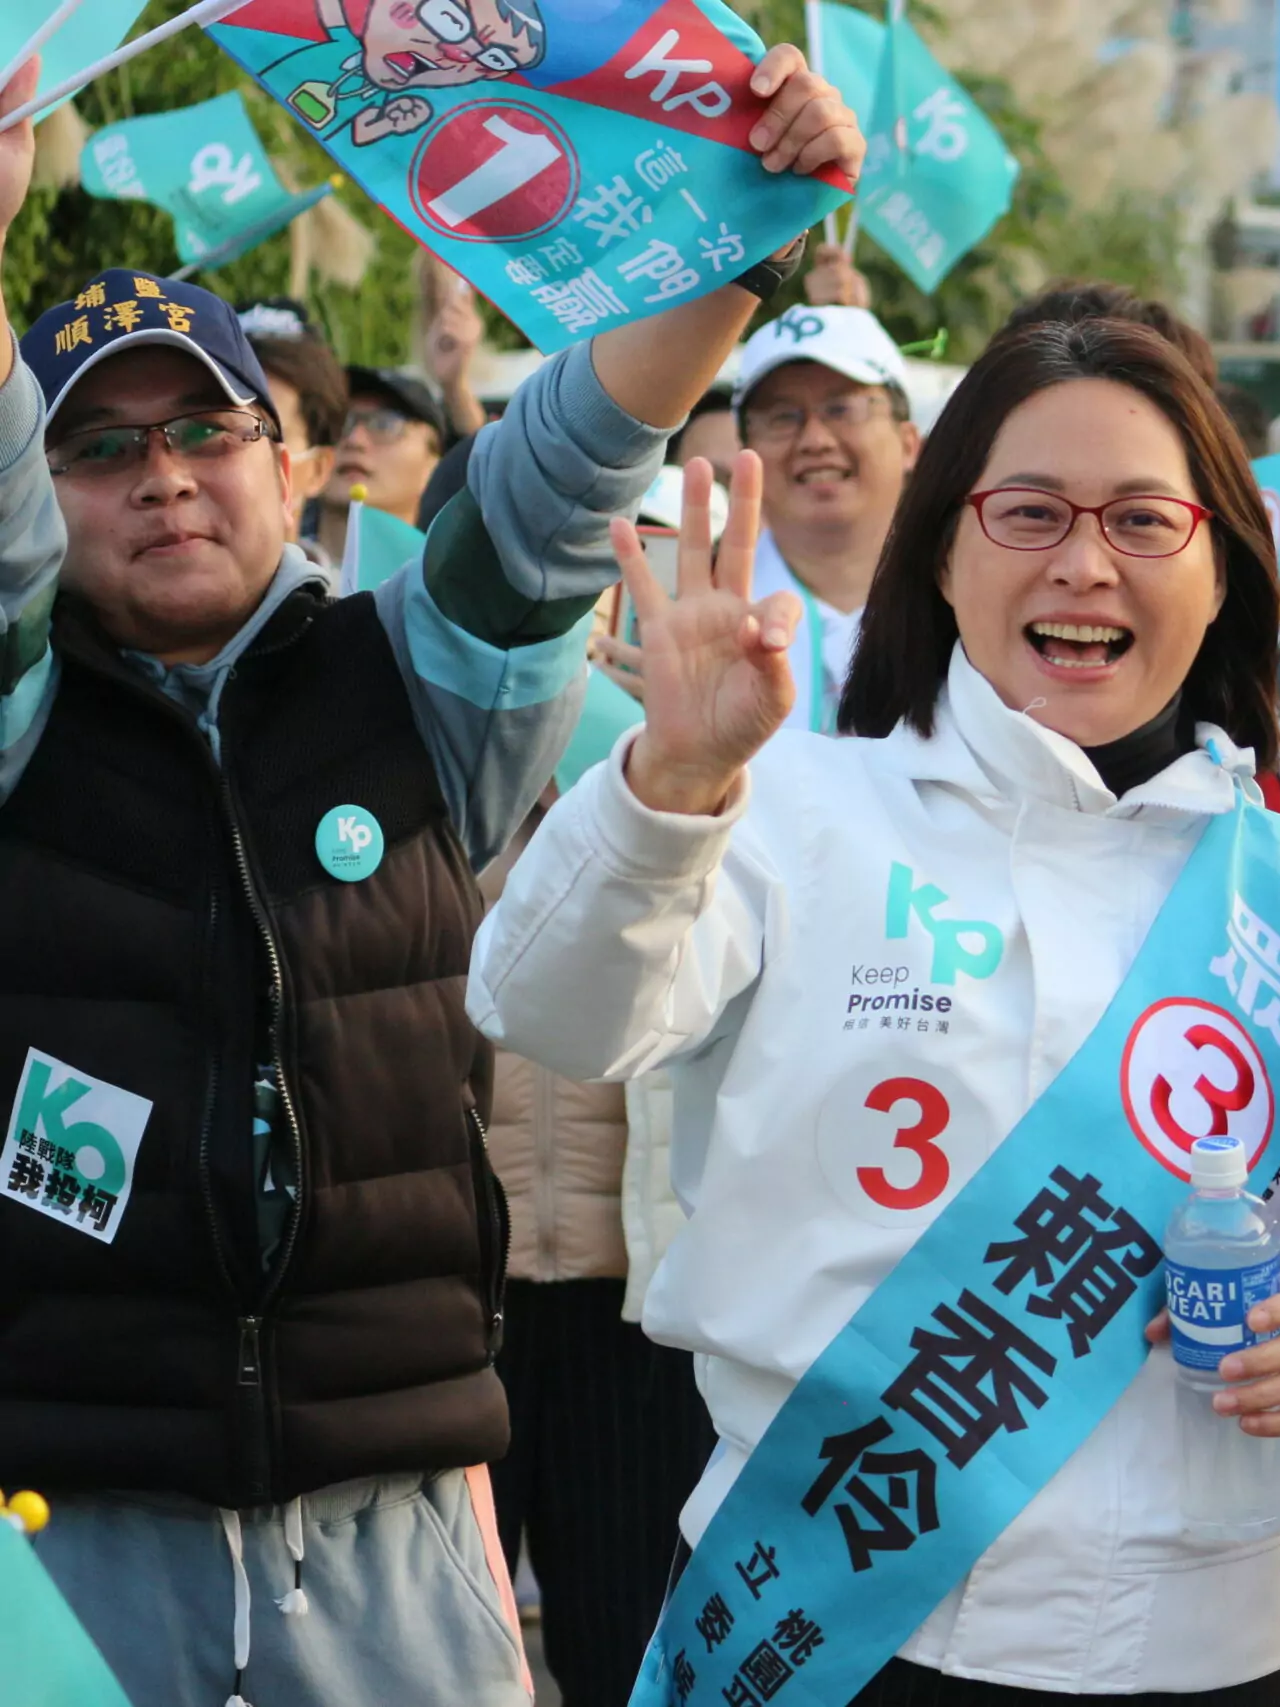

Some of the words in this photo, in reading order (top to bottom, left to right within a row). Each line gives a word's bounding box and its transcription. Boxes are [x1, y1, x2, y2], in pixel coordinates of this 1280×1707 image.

[624, 29, 731, 118] KP
[427, 114, 562, 228] 1
[635, 139, 745, 272] 這一次
[573, 175, 700, 303] 我們
[54, 300, 196, 355] 順澤宮
[847, 987, 952, 1013] Promise
[851, 965, 909, 989] Keep
[879, 1016, 950, 1034] 美好台灣
[1150, 1024, 1254, 1155] 3
[19, 1128, 76, 1171] 陸戰隊
[856, 1076, 950, 1210] 3
[800, 1164, 1165, 1573] 賴香伶
